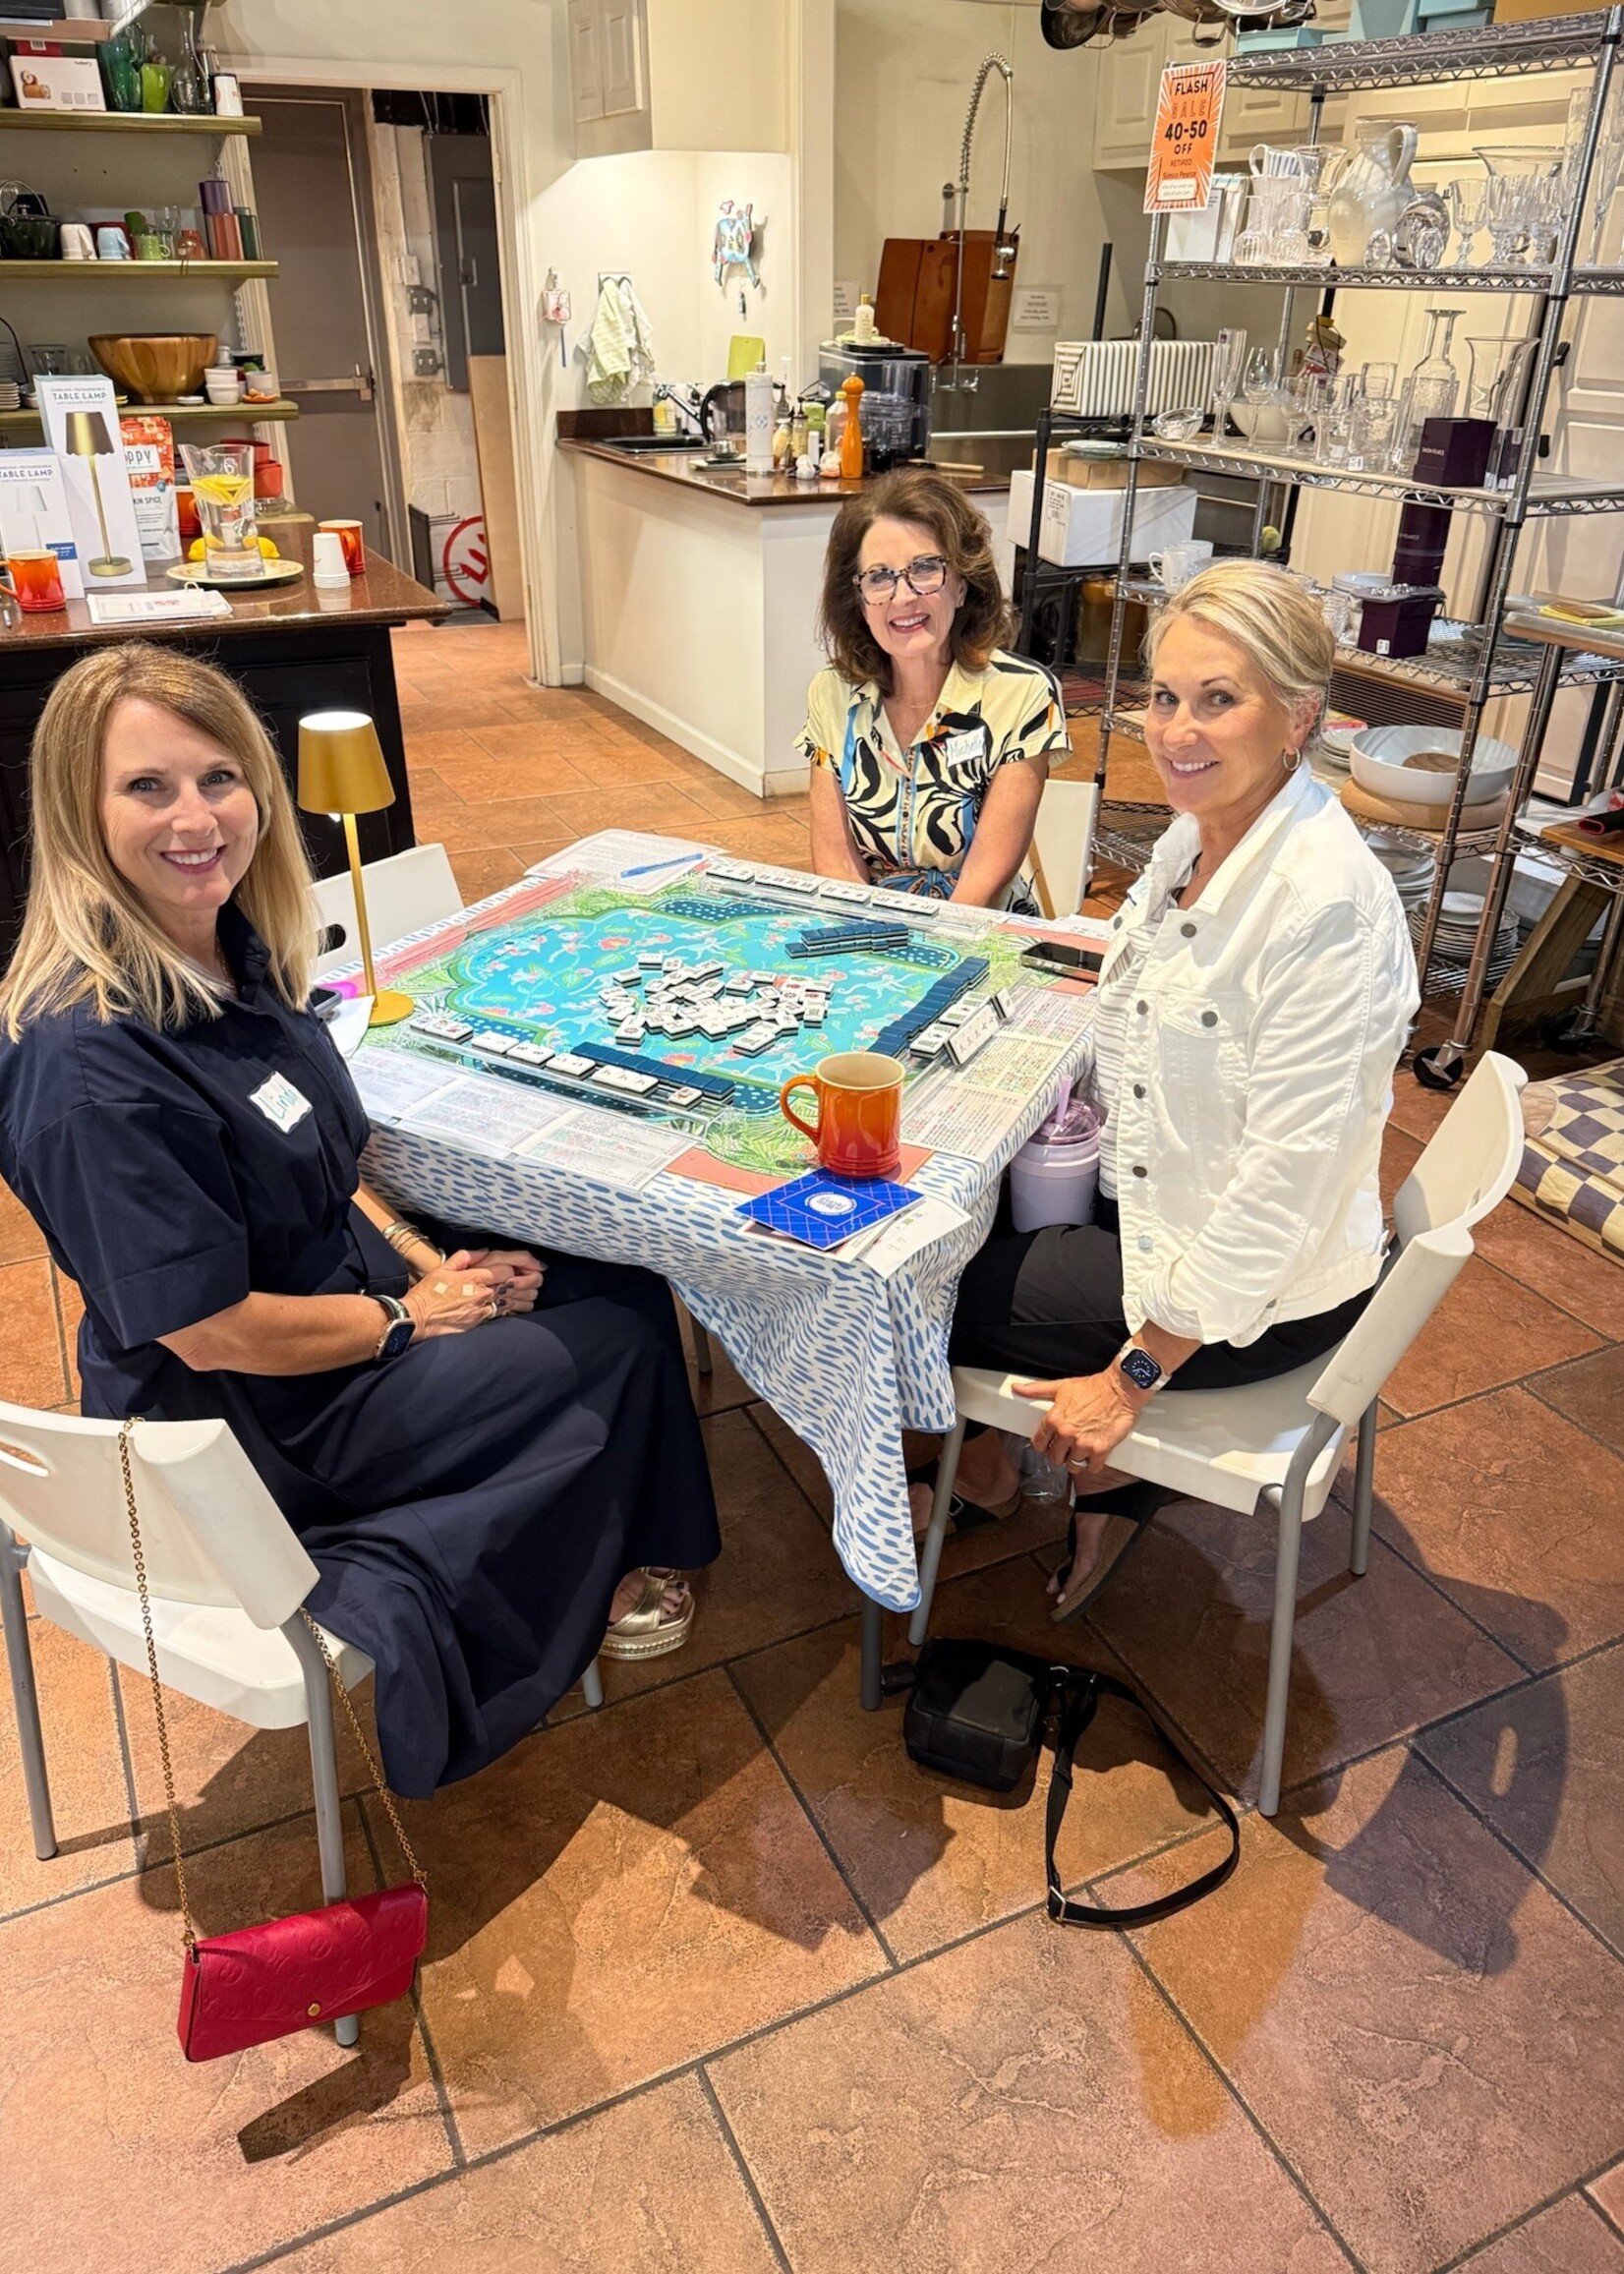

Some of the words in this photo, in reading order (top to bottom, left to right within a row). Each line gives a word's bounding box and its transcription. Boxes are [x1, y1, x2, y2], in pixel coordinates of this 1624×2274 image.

[1175, 79, 1208, 96] FLASH
[1171, 99, 1205, 119] SALE
[1165, 120, 1207, 142] 40-50
[1174, 143, 1192, 154] OFF
[1170, 157, 1192, 167] RETIRED
